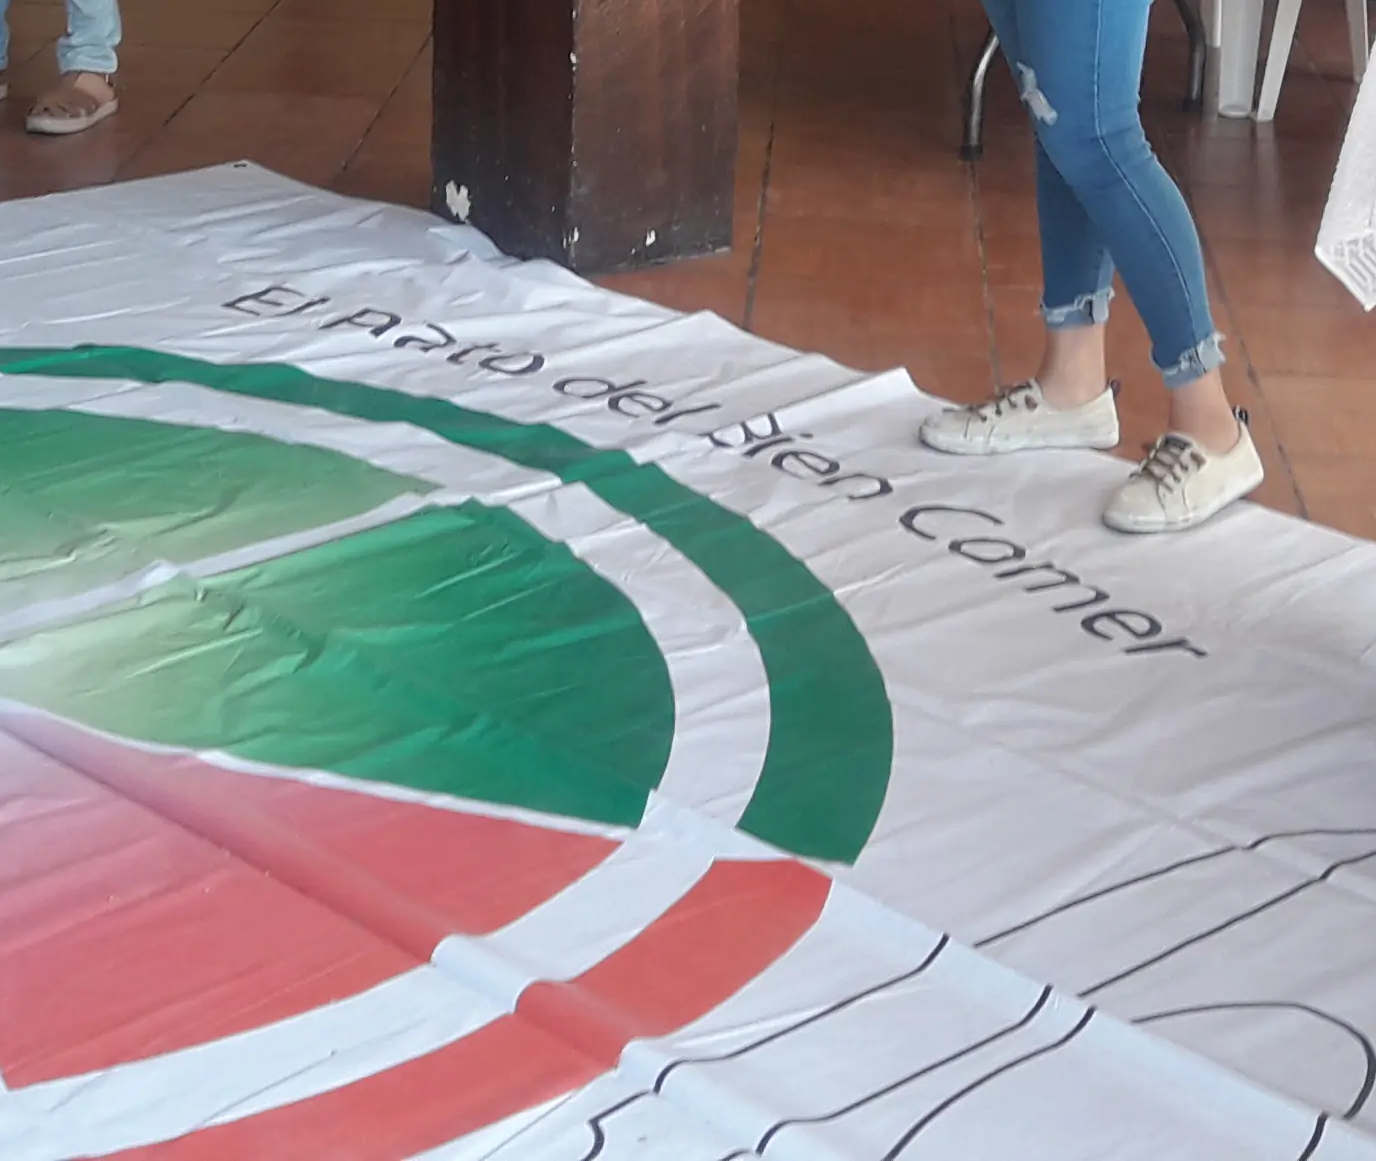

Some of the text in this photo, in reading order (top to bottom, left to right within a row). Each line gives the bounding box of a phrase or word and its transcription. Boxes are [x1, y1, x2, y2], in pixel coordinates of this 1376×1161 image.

[221, 285, 330, 317] El
[552, 376, 722, 425] del
[899, 504, 1208, 658] Comer
